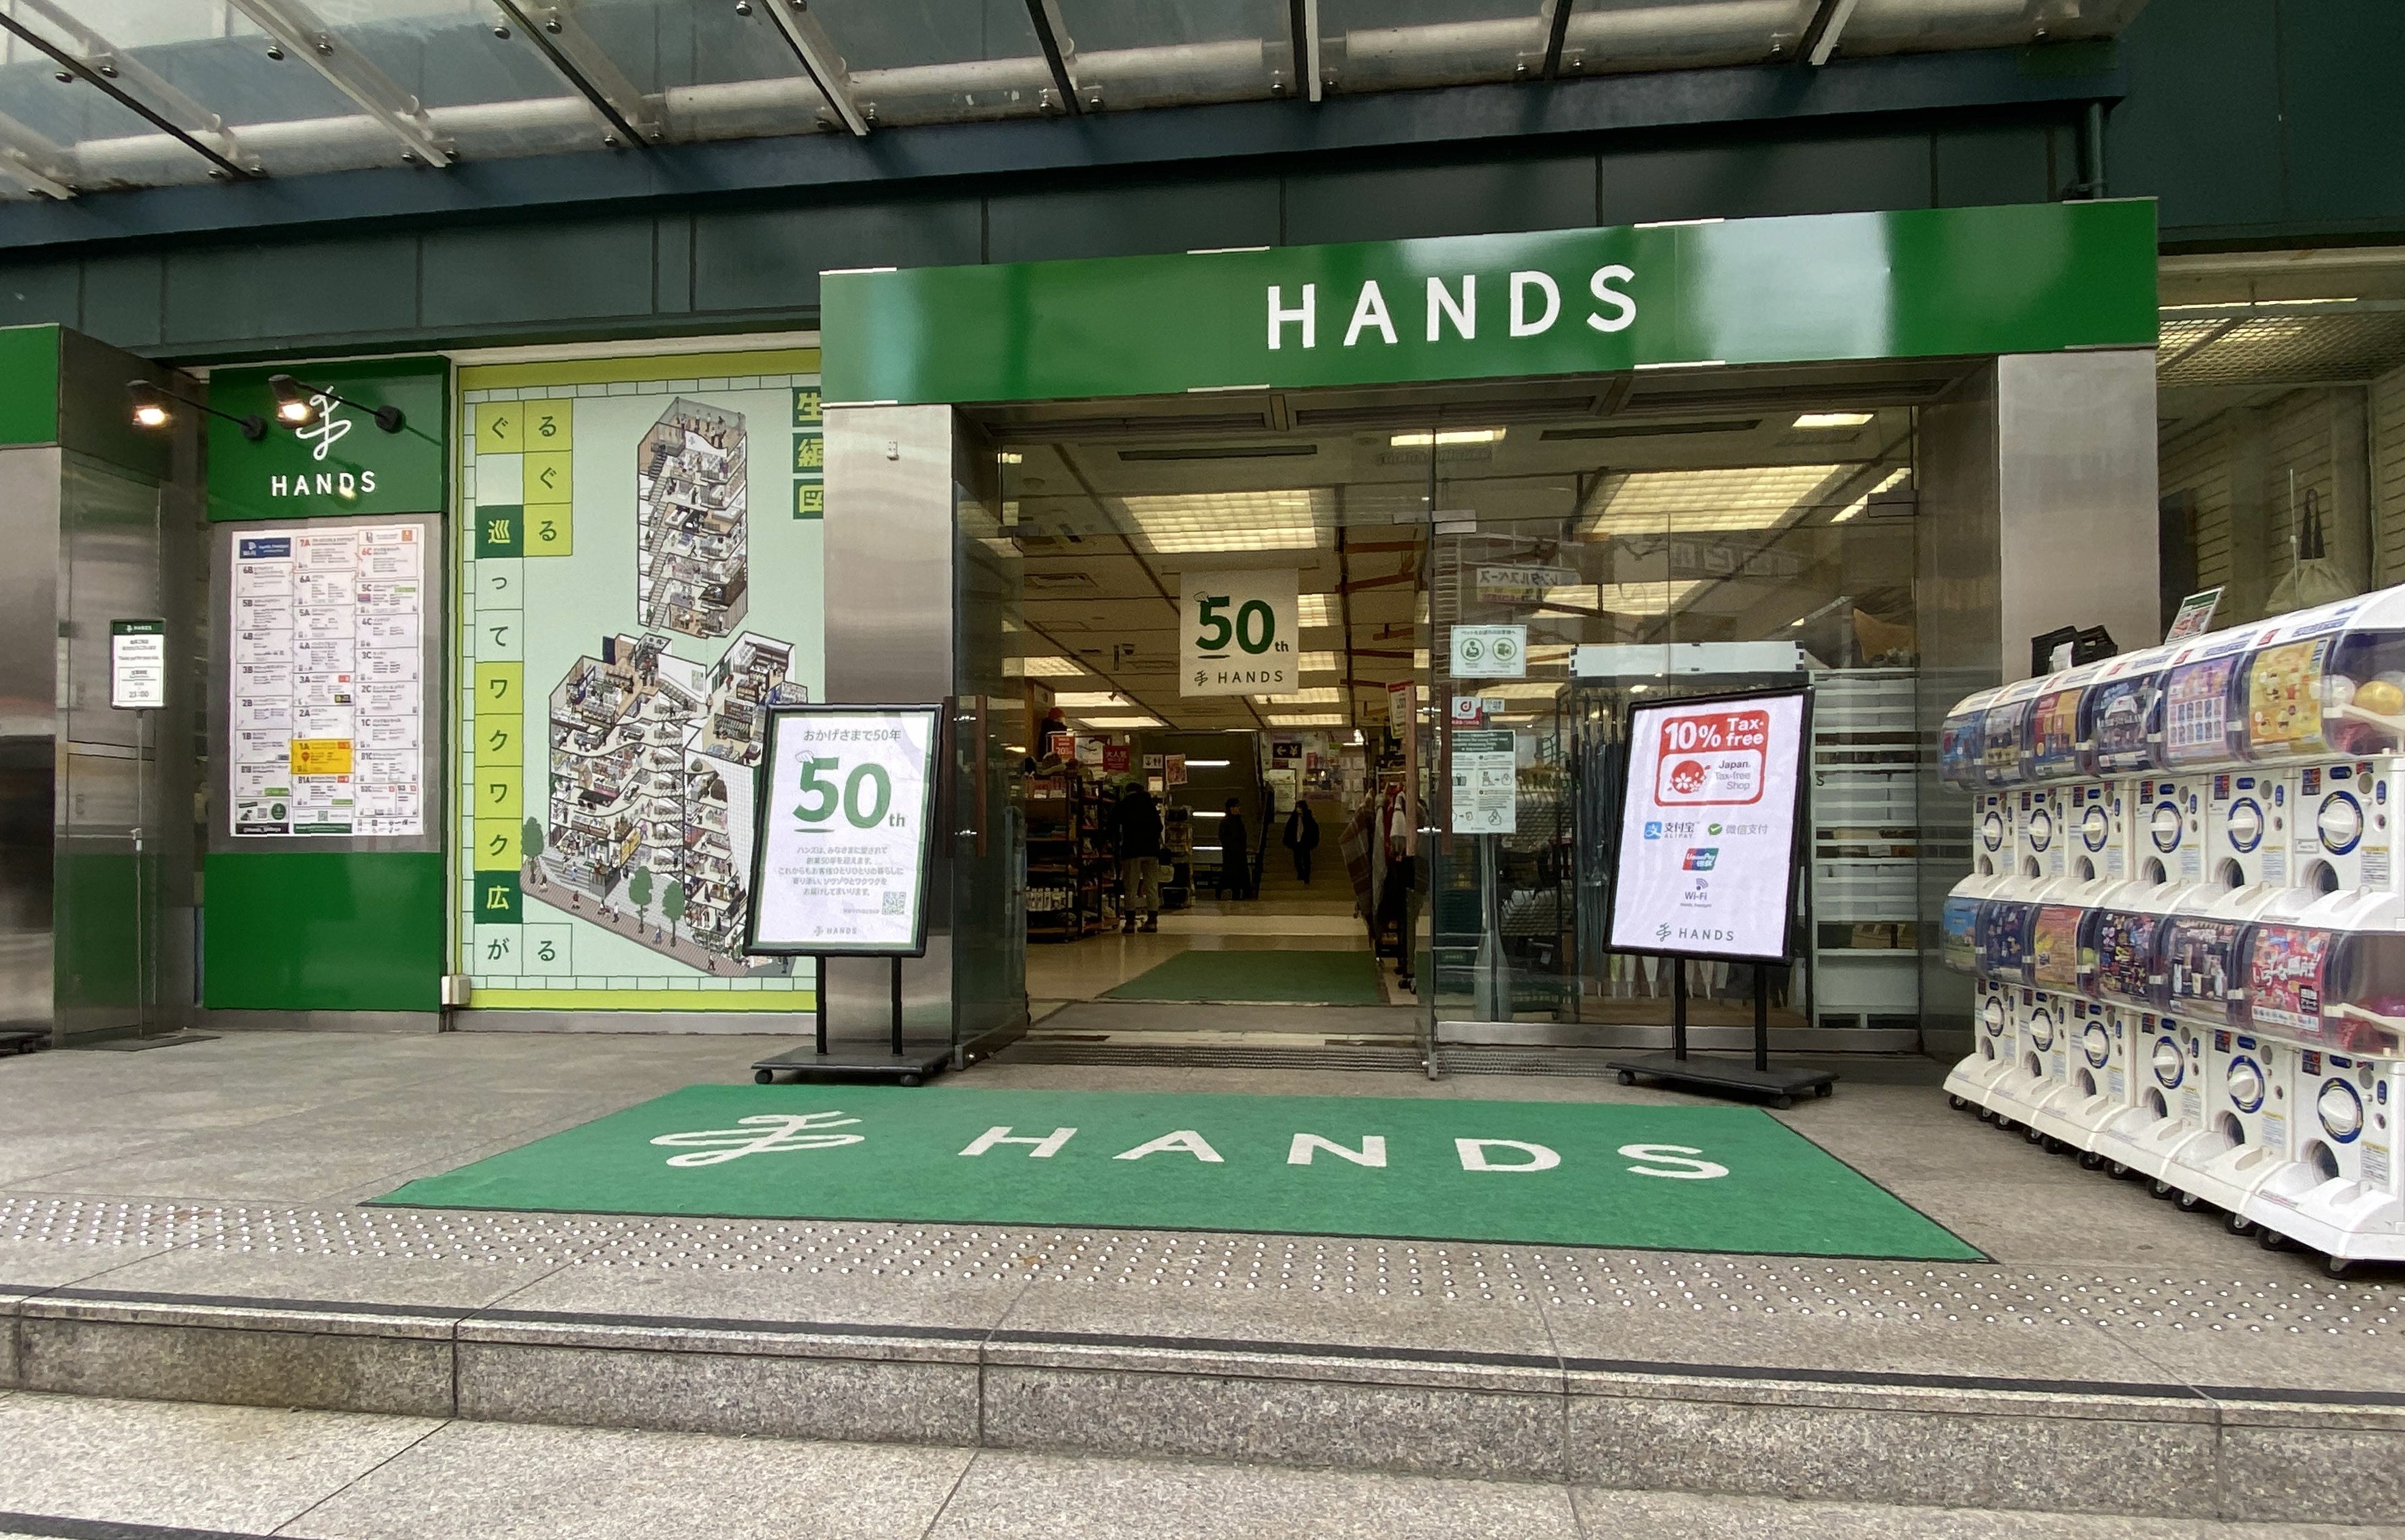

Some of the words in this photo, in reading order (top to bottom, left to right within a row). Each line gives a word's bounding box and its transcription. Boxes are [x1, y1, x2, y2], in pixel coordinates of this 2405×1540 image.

[1268, 264, 1637, 350] HANDS
[272, 471, 376, 497] HANDS
[1218, 671, 1283, 684] HANDS
[803, 729, 902, 742] おかげさまで50年
[1664, 721, 1722, 750] 10%
[1726, 732, 1764, 746] free
[1716, 771, 1751, 780] Tax-free
[1726, 782, 1750, 792] Shop
[1664, 821, 1694, 833] 支付宝
[1726, 824, 1769, 835] 微信支付
[1684, 891, 1708, 900] Wi-Fi
[1679, 927, 1734, 941] HANDS
[957, 1126, 1730, 1180] HANDS
